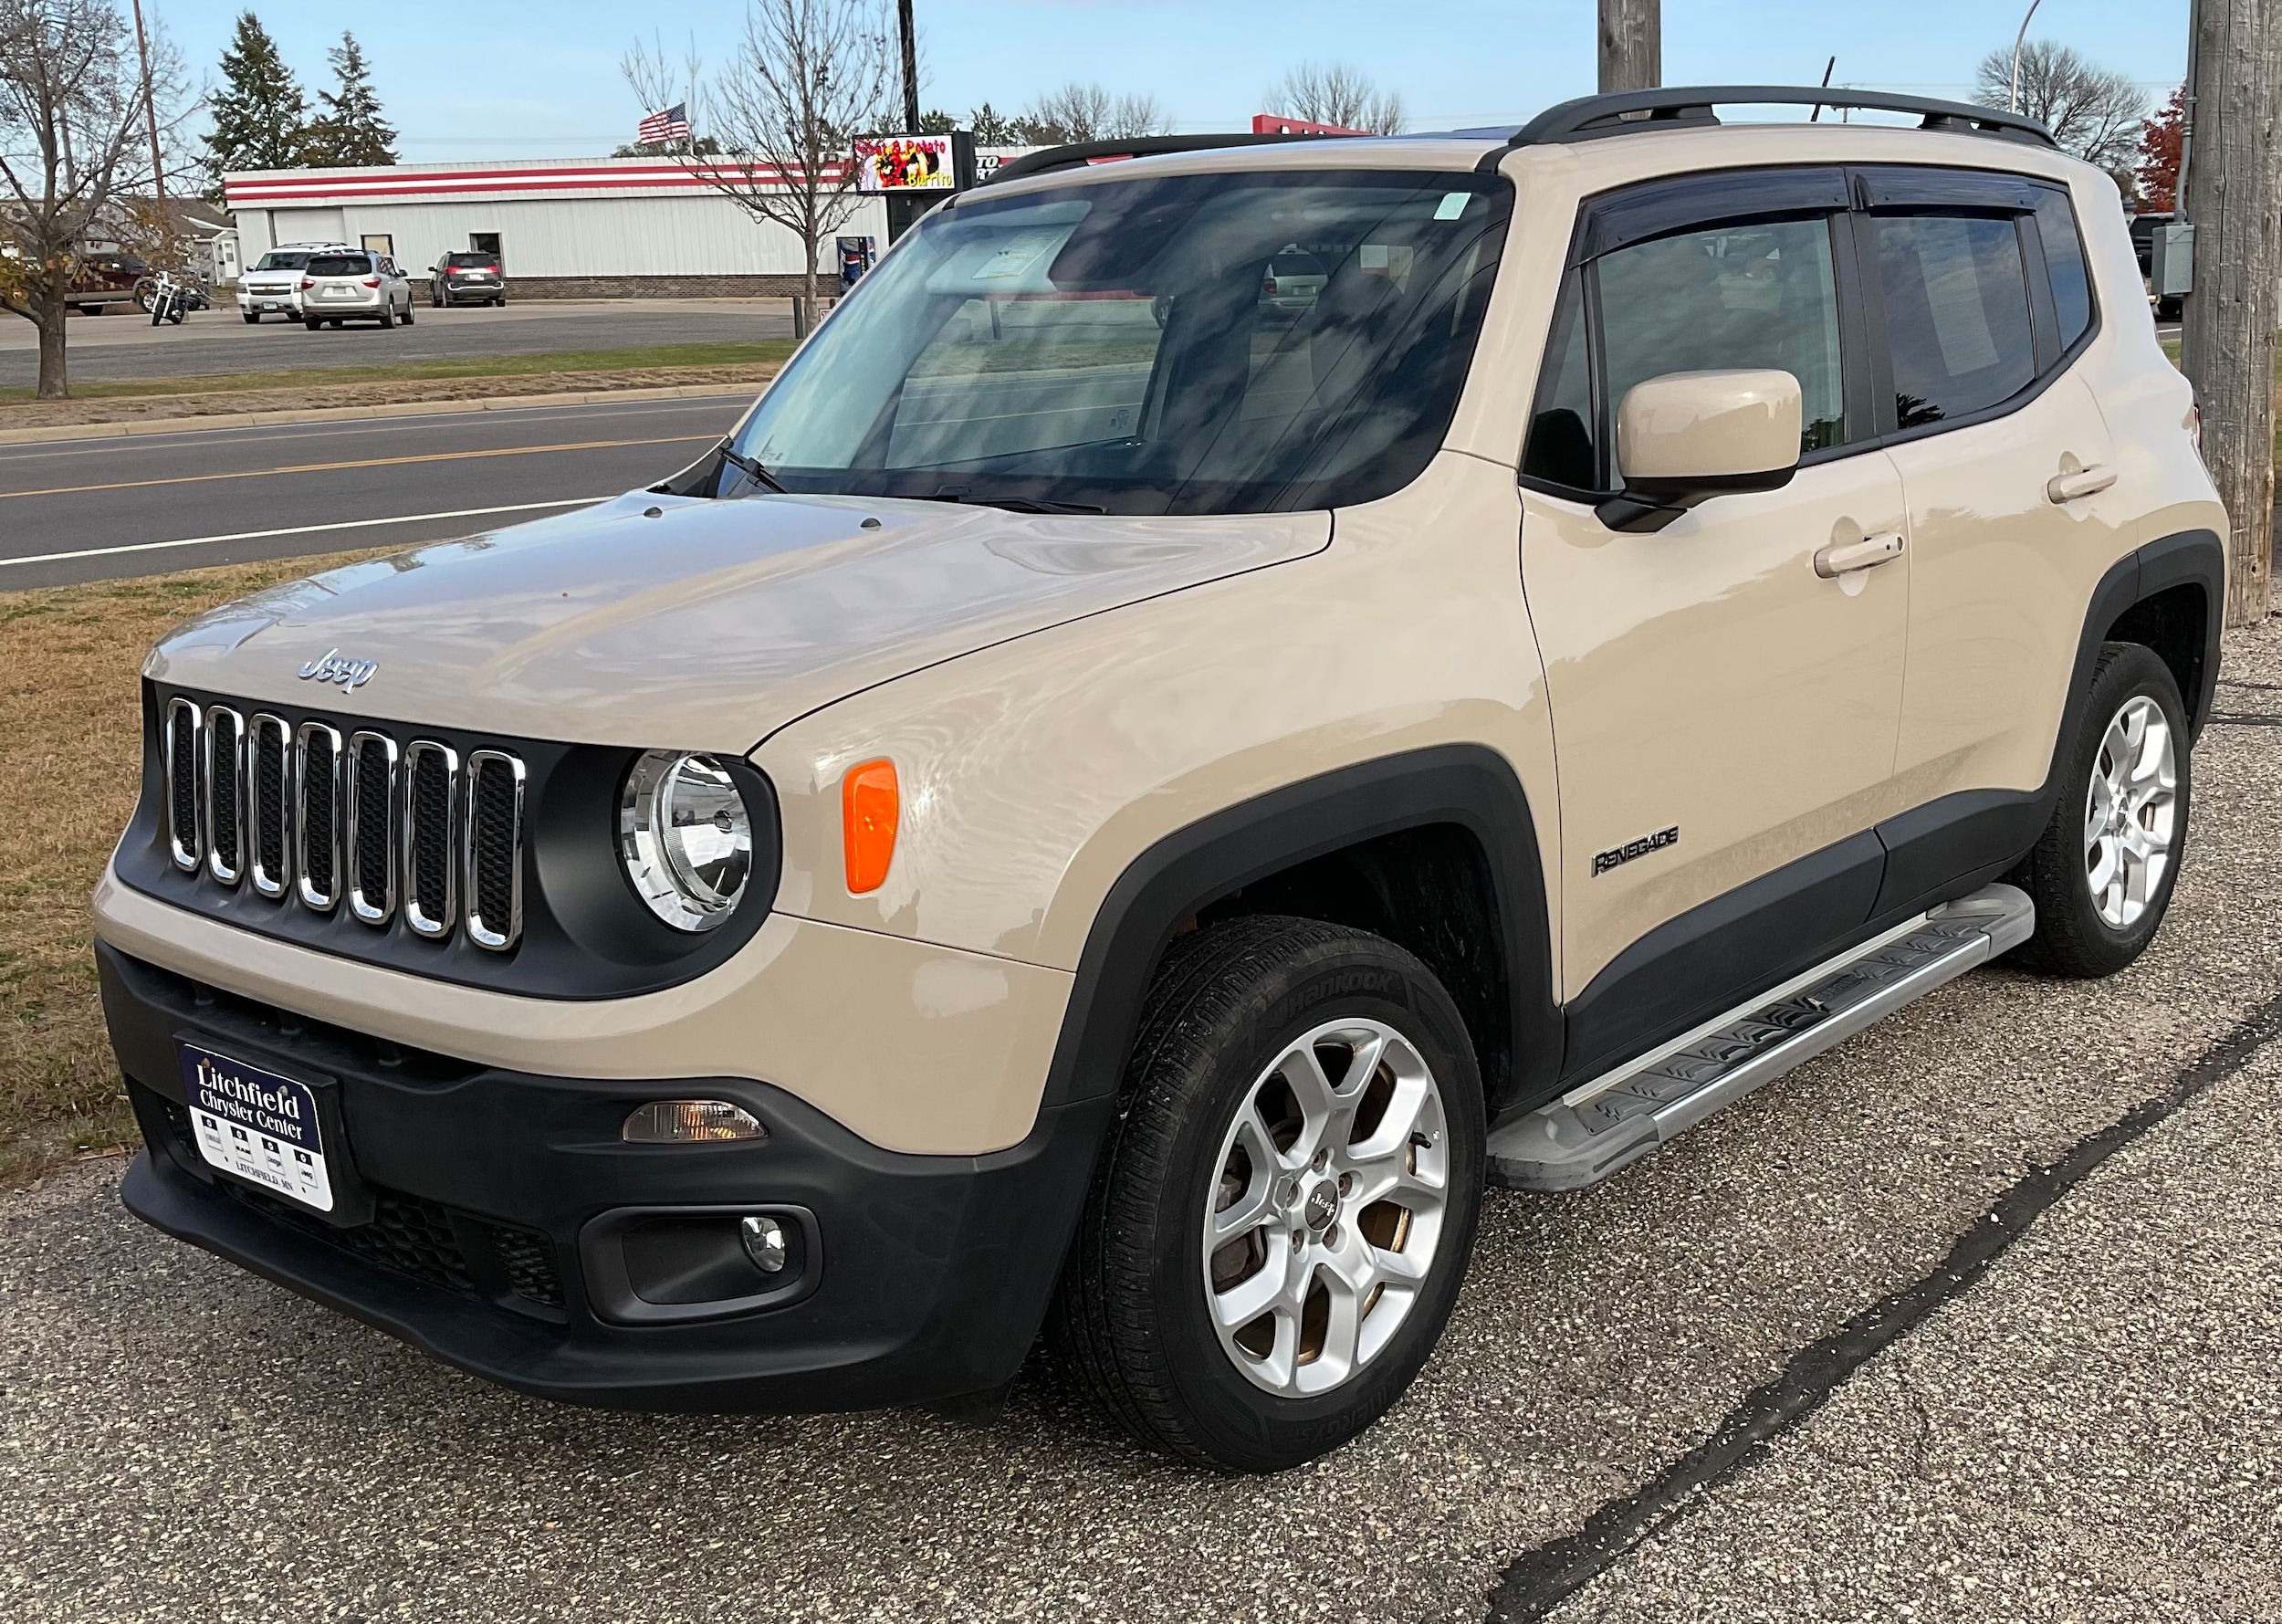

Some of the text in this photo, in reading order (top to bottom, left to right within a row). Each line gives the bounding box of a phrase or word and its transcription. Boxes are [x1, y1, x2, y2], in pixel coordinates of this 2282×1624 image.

[906, 140, 946, 154] Potato
[908, 172, 952, 187] Burrito
[298, 647, 379, 695] Jeep
[1591, 824, 1679, 878] RENEGADE
[196, 1063, 300, 1120] Litchfield
[200, 1089, 302, 1140] Chrysler Center
[281, 1179, 294, 1191] MN
[1311, 1192, 1335, 1217] Jeep
